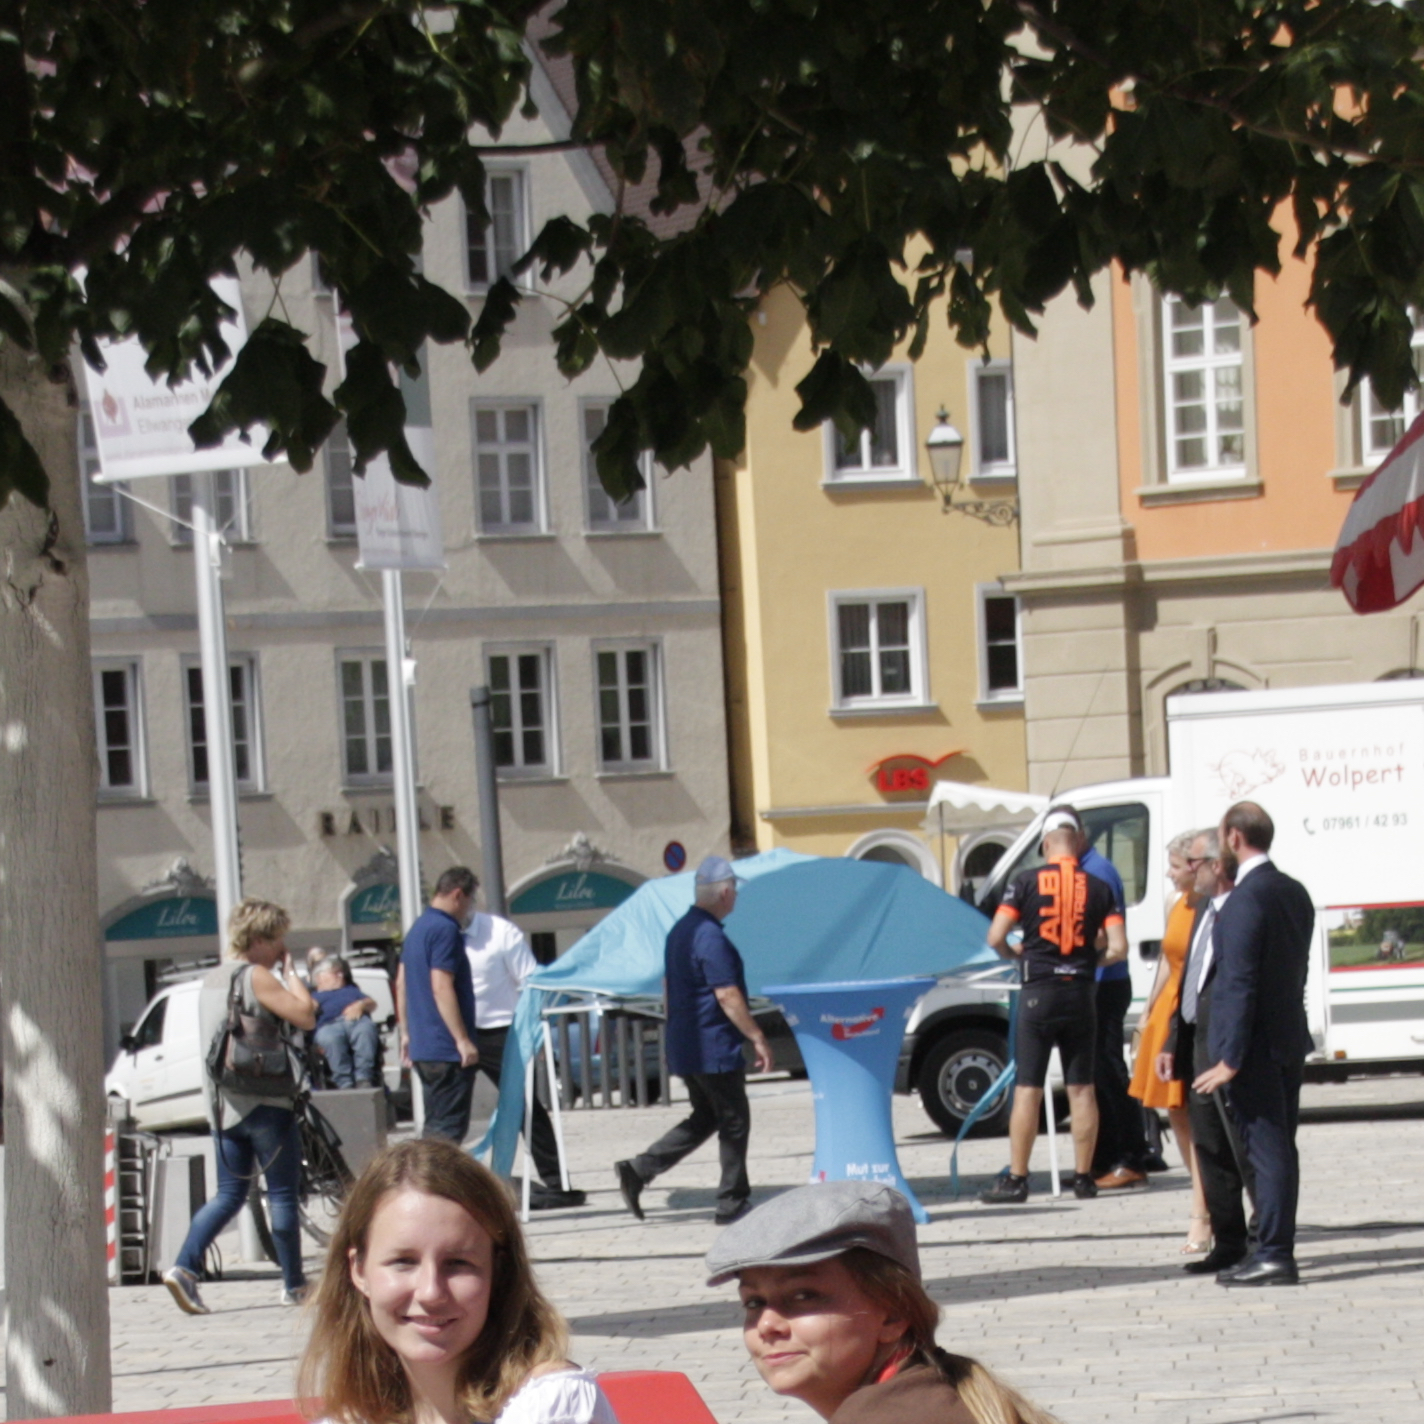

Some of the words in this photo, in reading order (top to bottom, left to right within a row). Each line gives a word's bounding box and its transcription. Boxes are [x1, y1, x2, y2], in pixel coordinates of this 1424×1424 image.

[1299, 743, 1405, 762] Bauernhof
[878, 767, 930, 792] LBS
[1301, 764, 1406, 791] Wolpert
[1038, 869, 1061, 946] ALB
